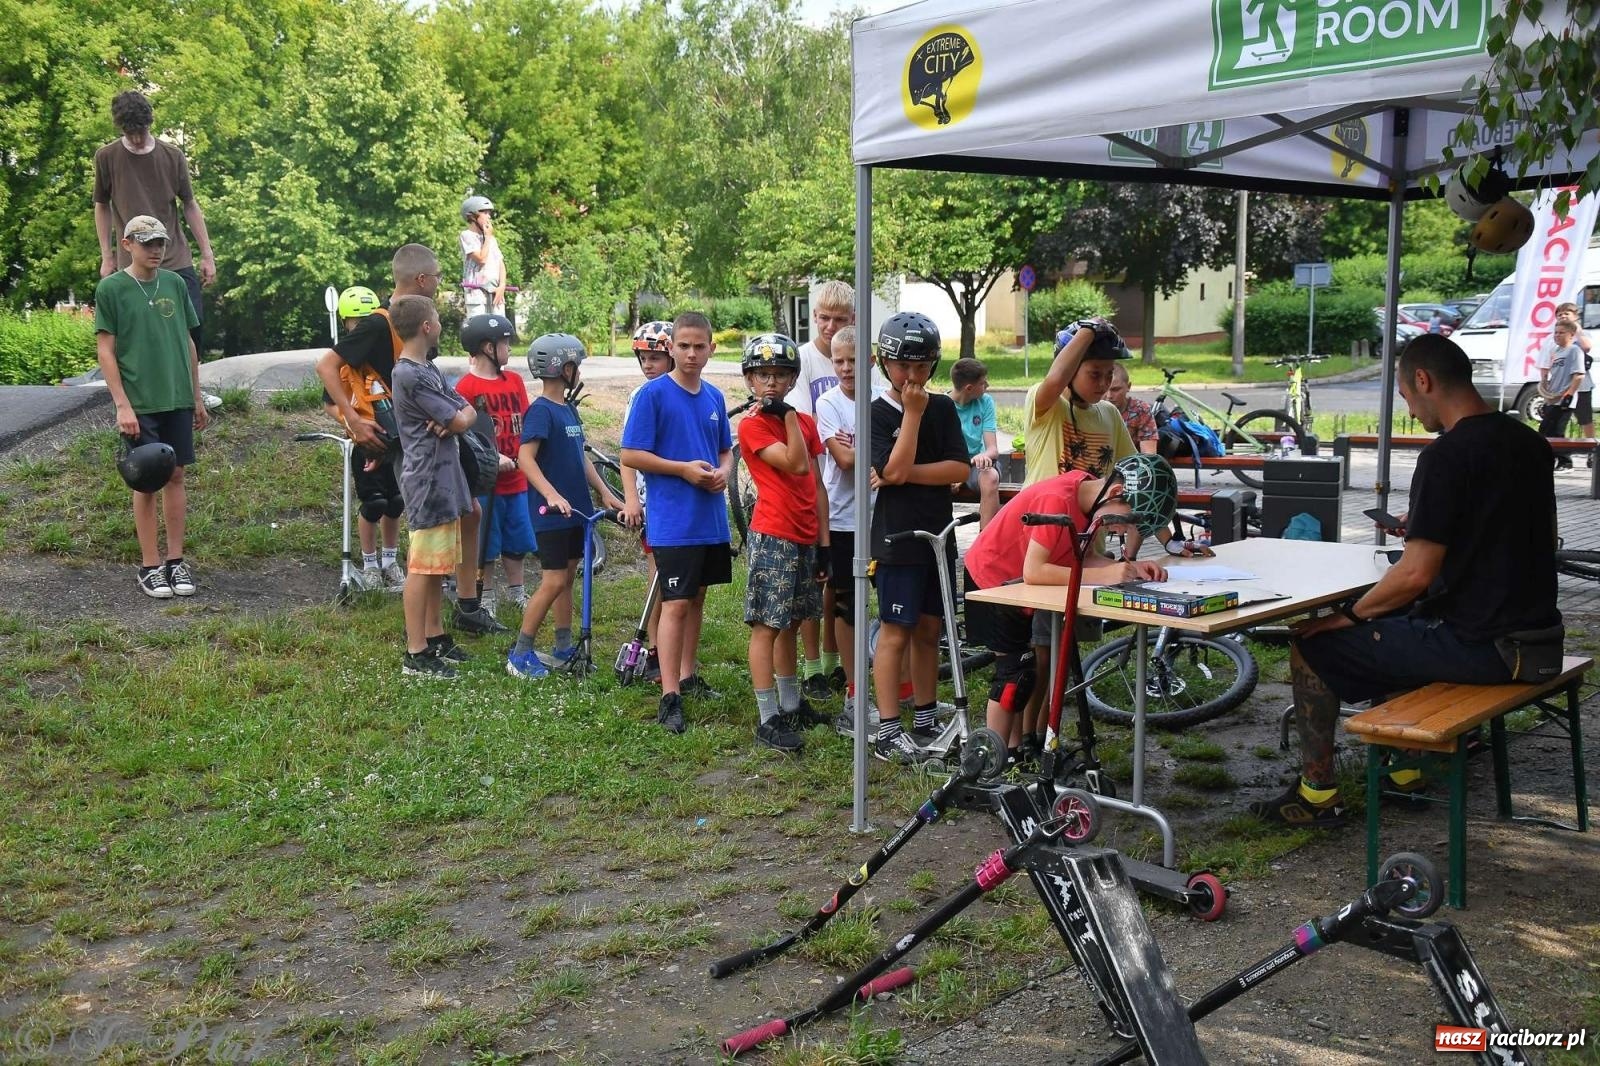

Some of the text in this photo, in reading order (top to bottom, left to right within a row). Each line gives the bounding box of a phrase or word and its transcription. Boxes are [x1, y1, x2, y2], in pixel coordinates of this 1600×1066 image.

[1315, 0, 1460, 48] ROOM
[926, 37, 960, 54] EXTREME
[924, 51, 960, 74] CITY
